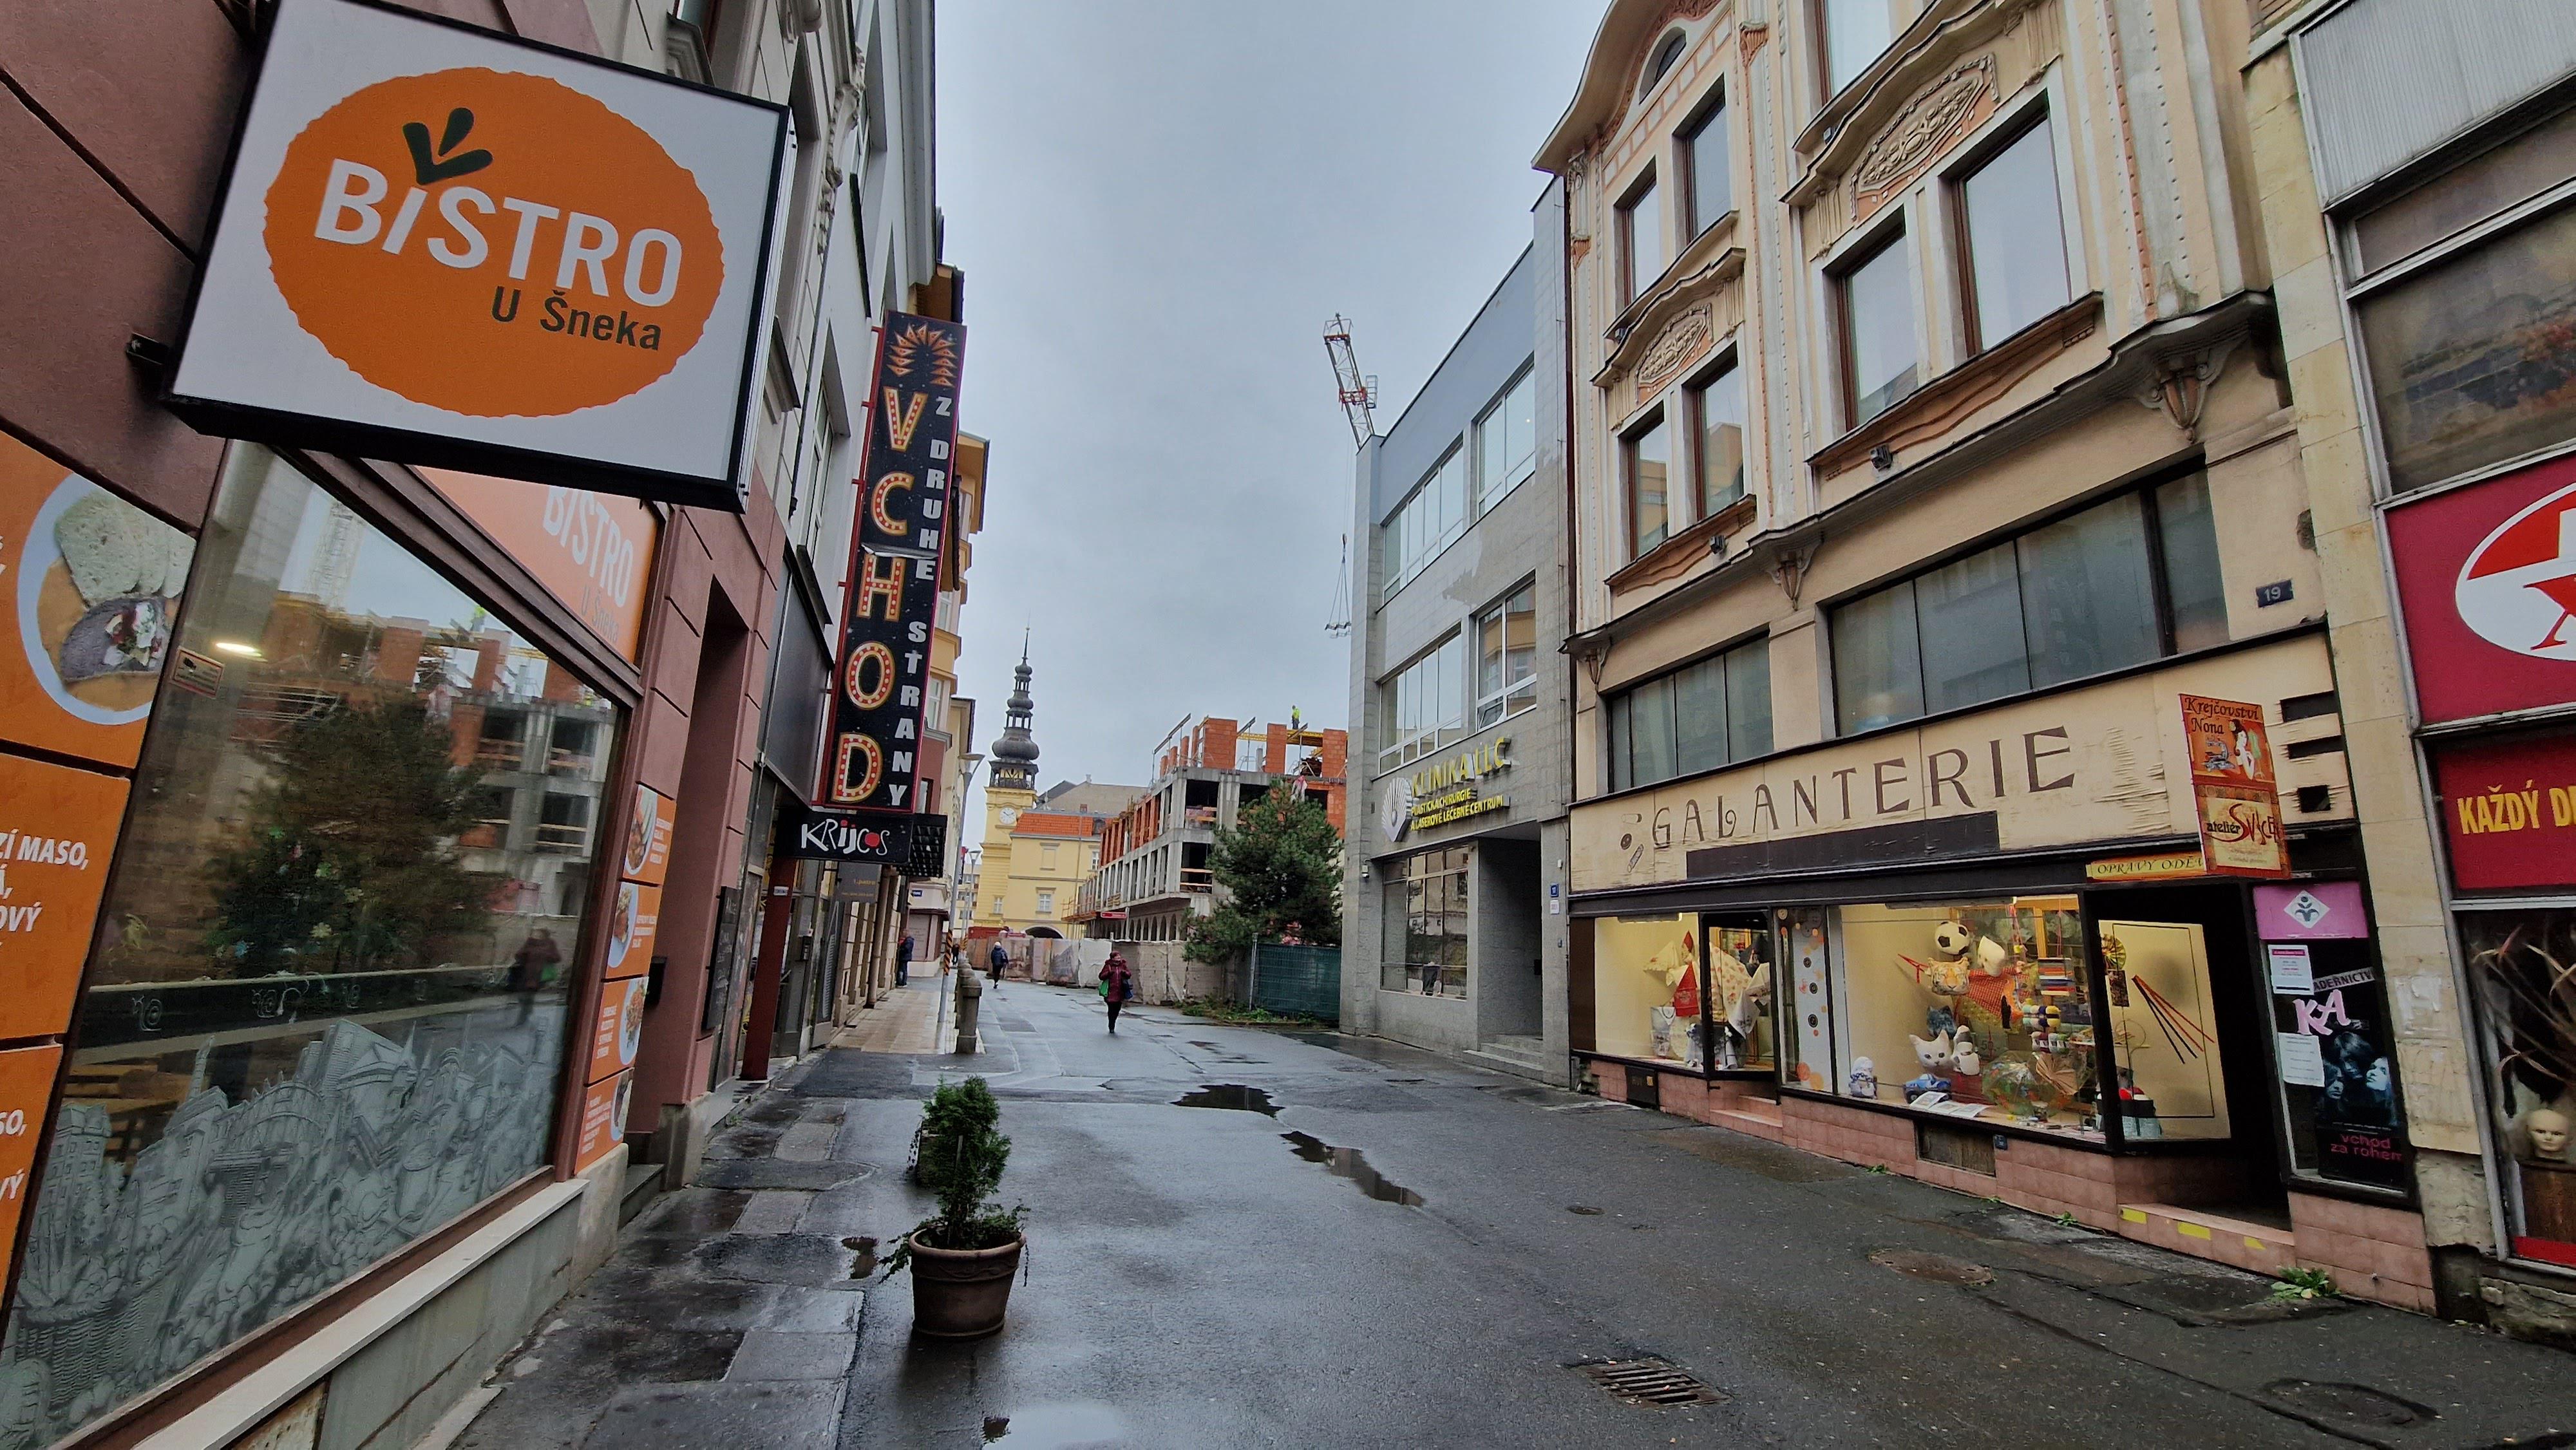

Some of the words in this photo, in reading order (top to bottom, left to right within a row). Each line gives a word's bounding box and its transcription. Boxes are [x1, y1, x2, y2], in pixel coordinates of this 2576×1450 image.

[314, 159, 683, 307] BISTRO
[490, 286, 521, 323] U
[540, 289, 662, 352] Šneka
[935, 397, 952, 417] Z
[833, 386, 928, 804] VCHOD
[2264, 587, 2281, 602] 19
[889, 620, 927, 807] STRANY
[2184, 697, 2259, 720] Krejčovství
[2192, 717, 2224, 735] Nona
[1412, 753, 1475, 797] KLINIKA
[1475, 736, 1511, 776] LLC
[1651, 725, 2075, 850] GALANTERIE
[2456, 779, 2541, 834] KAŽDÝ
[17, 835, 89, 870] MASO,
[2098, 860, 2157, 874] OPRAVY
[2331, 1144, 2348, 1154] za
[2341, 1134, 2391, 1149] vchod
